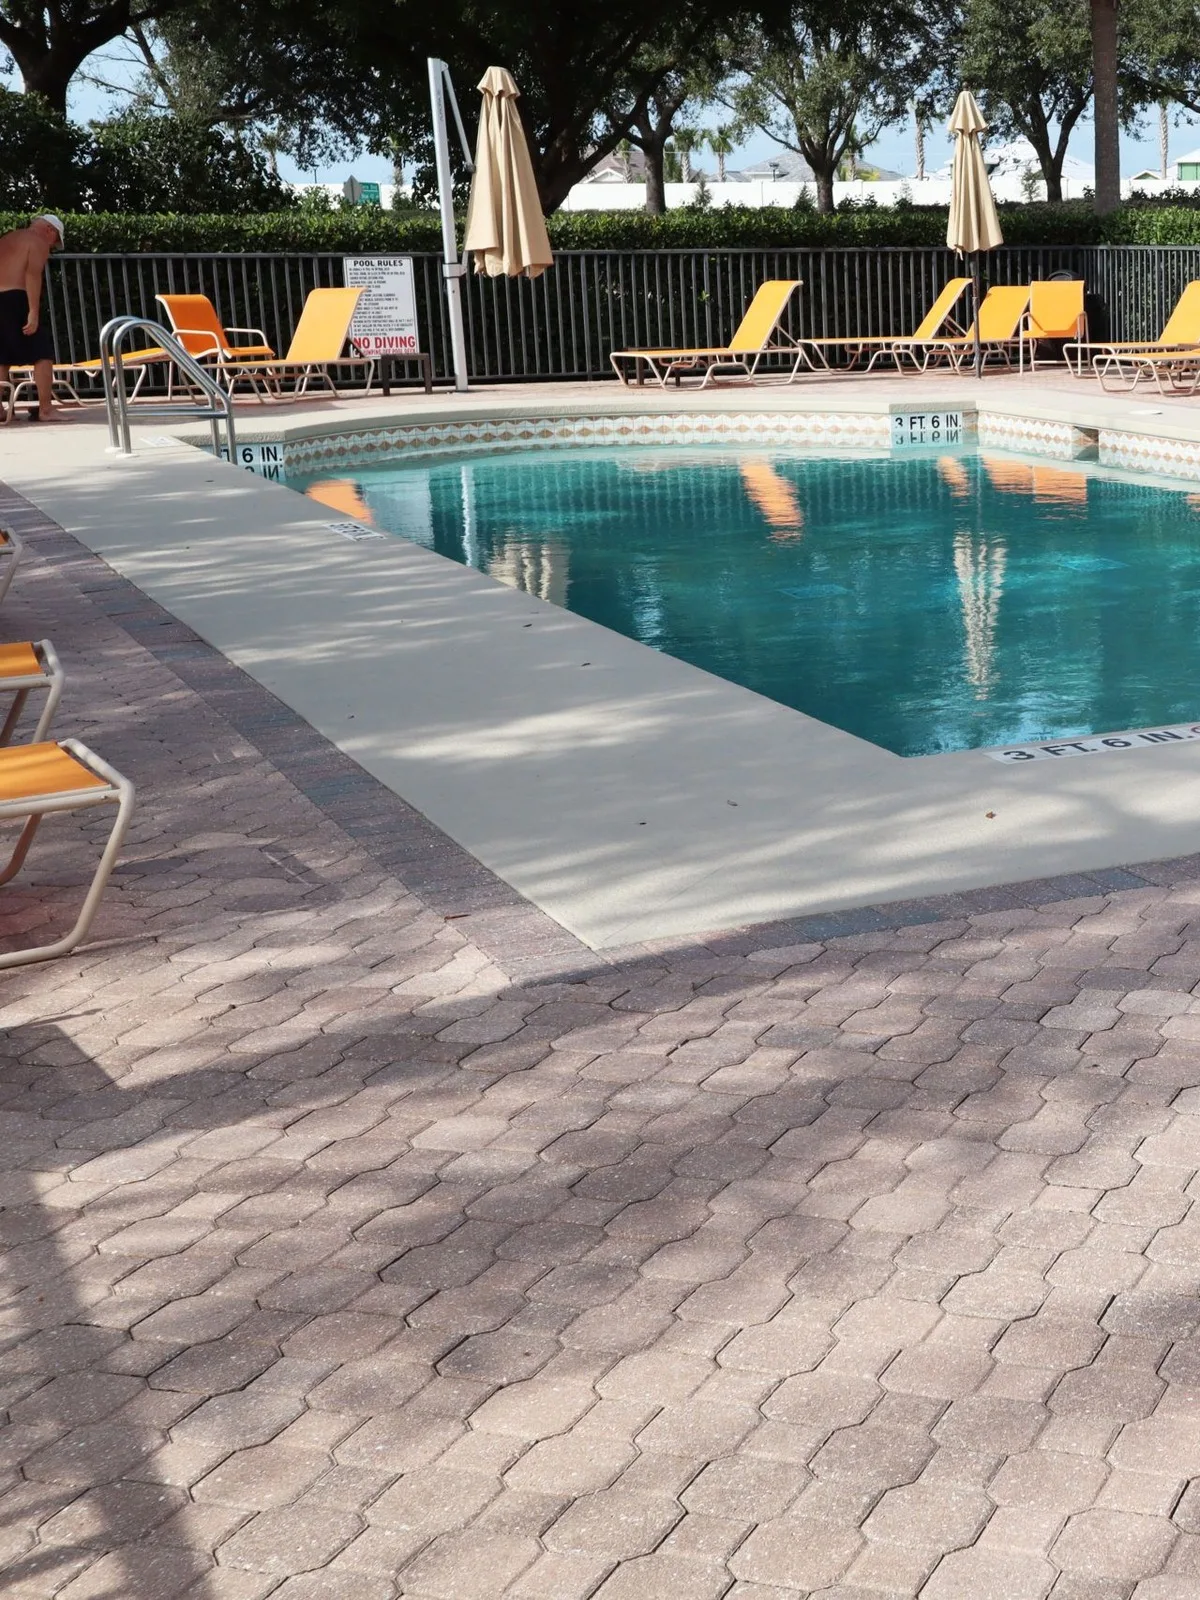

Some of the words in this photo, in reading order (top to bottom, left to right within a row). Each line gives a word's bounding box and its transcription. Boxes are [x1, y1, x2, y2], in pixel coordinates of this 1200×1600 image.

[354, 337, 370, 349] NO
[375, 336, 416, 349] DIVING
[931, 415, 940, 429] 6
[946, 414, 961, 428] IN.
[242, 447, 254, 463] 6
[261, 446, 283, 462] IN.
[1003, 750, 1035, 761] 3
[1039, 742, 1098, 756] FT.
[1101, 738, 1132, 748] 6
[1137, 731, 1193, 744] IN.
